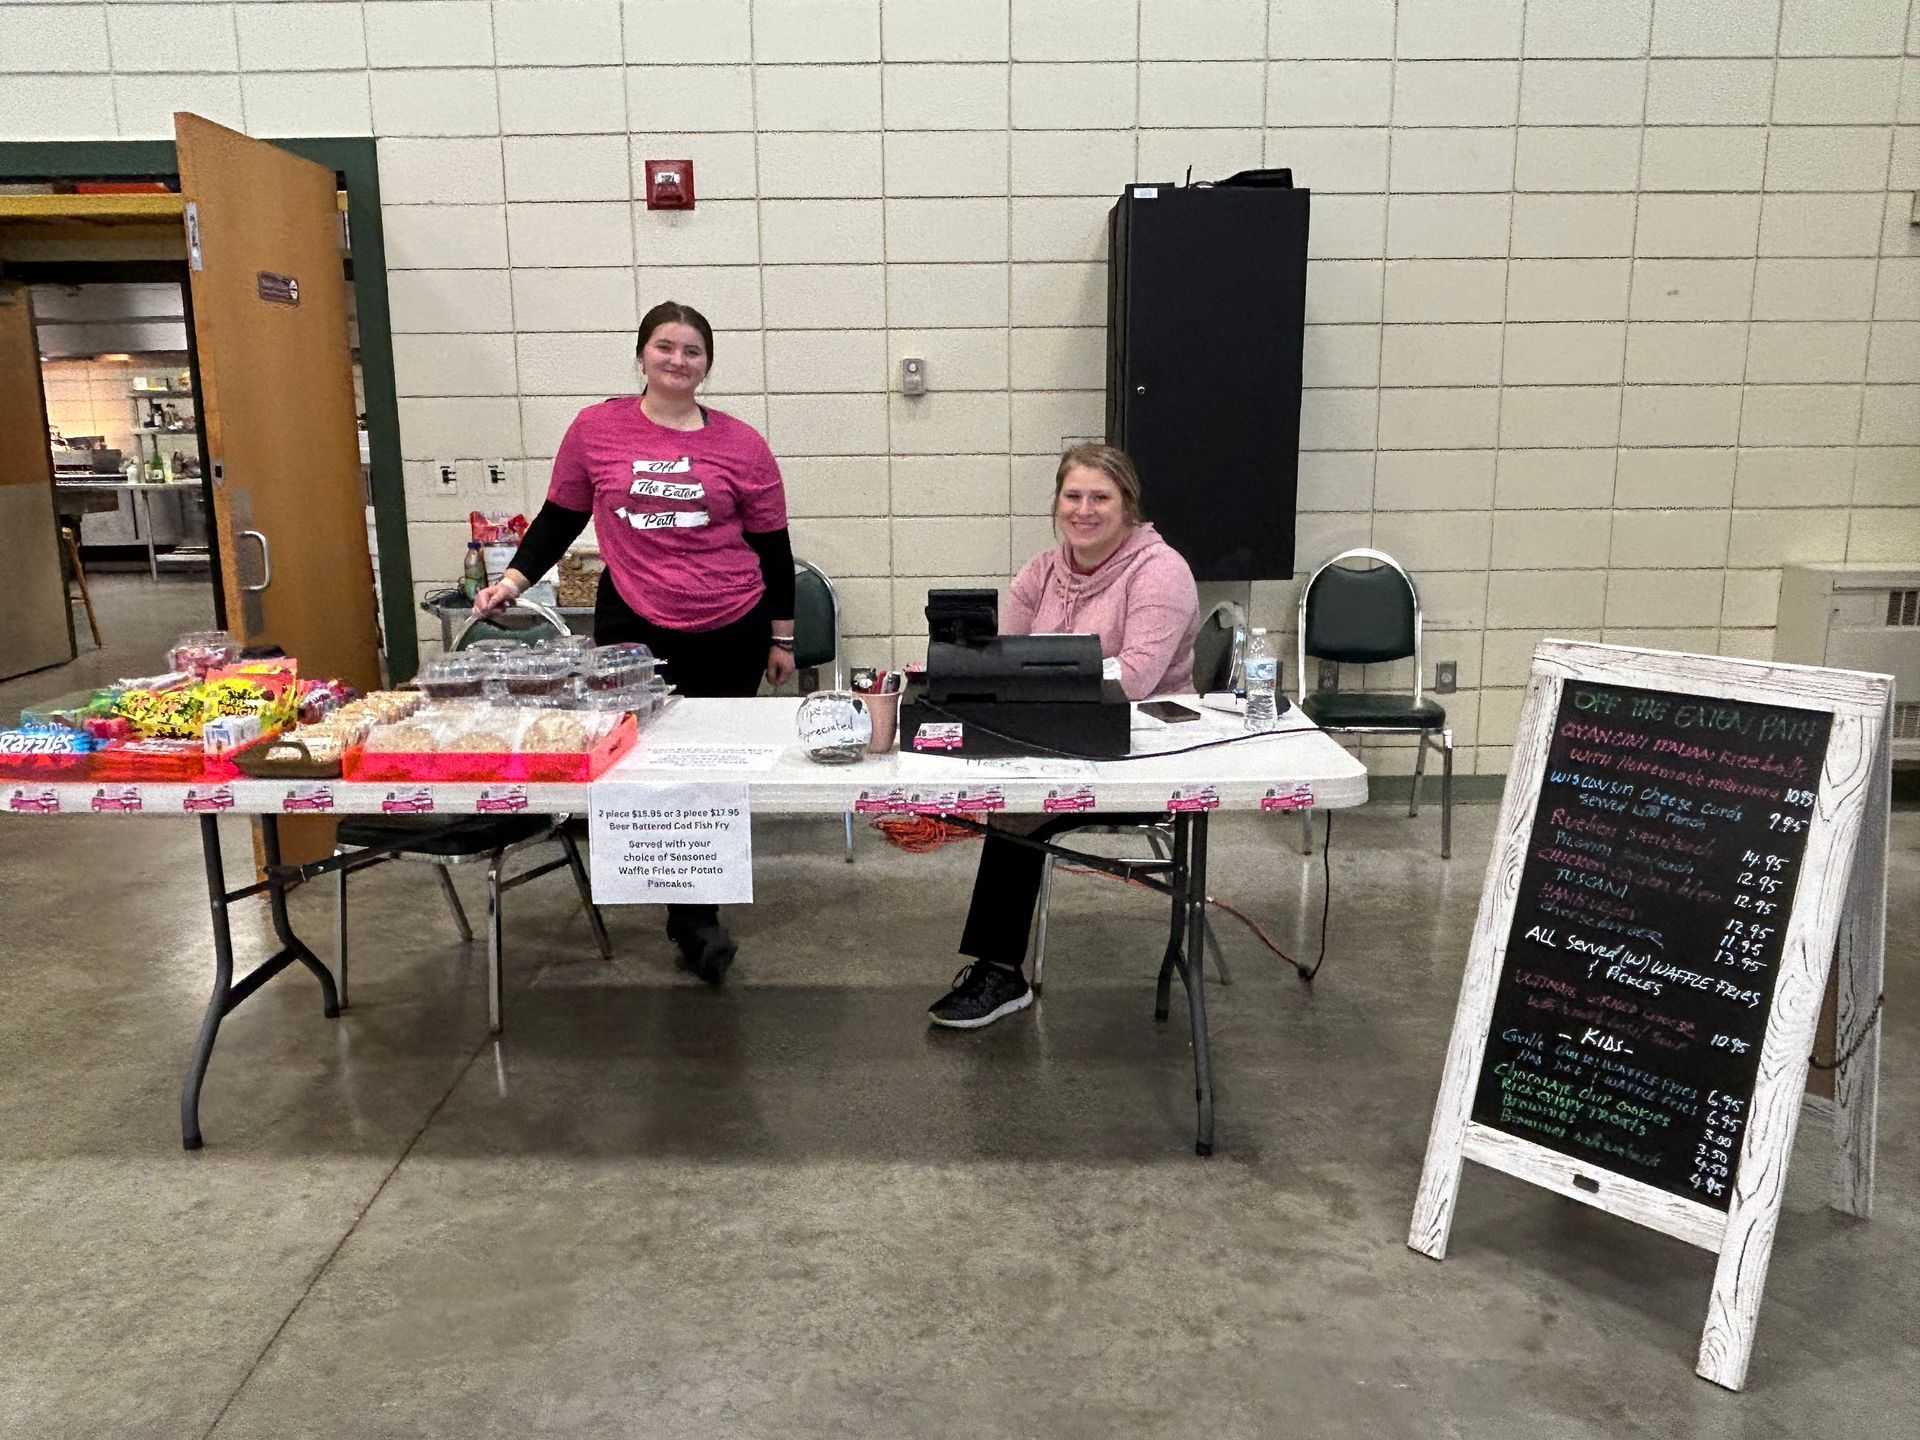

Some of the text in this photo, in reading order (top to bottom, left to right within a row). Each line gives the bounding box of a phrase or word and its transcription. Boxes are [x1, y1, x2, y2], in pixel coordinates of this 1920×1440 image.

[648, 462, 677, 473] Off
[639, 481, 697, 498] The Eaten
[643, 512, 677, 527] Path
[1574, 691, 1620, 714] OFF
[598, 810, 604, 818] 2
[606, 810, 630, 820] piece
[676, 810, 682, 818] 3
[683, 810, 708, 819] piece
[710, 808, 740, 818] $17.95
[609, 821, 730, 831] Beer Battered Cod Fish Fry
[628, 840, 711, 850] Served with your
[623, 852, 717, 862] choice of Seasoned
[1741, 850, 1790, 871] 14.95
[618, 866, 650, 875] Waffle
[652, 867, 674, 876] Fries
[690, 866, 724, 875] Potato
[647, 880, 695, 889] Pancakes.
[1737, 872, 1783, 894] 12.95
[1734, 894, 1778, 915] 12.95
[1725, 918, 1774, 940] 12.95
[1720, 935, 1764, 956] 11.95
[1713, 949, 1768, 972] 13.95
[1650, 961, 1714, 990] WAFFLE
[1707, 1089, 1745, 1112] 6.95
[1696, 1143, 1728, 1163] 3.50
